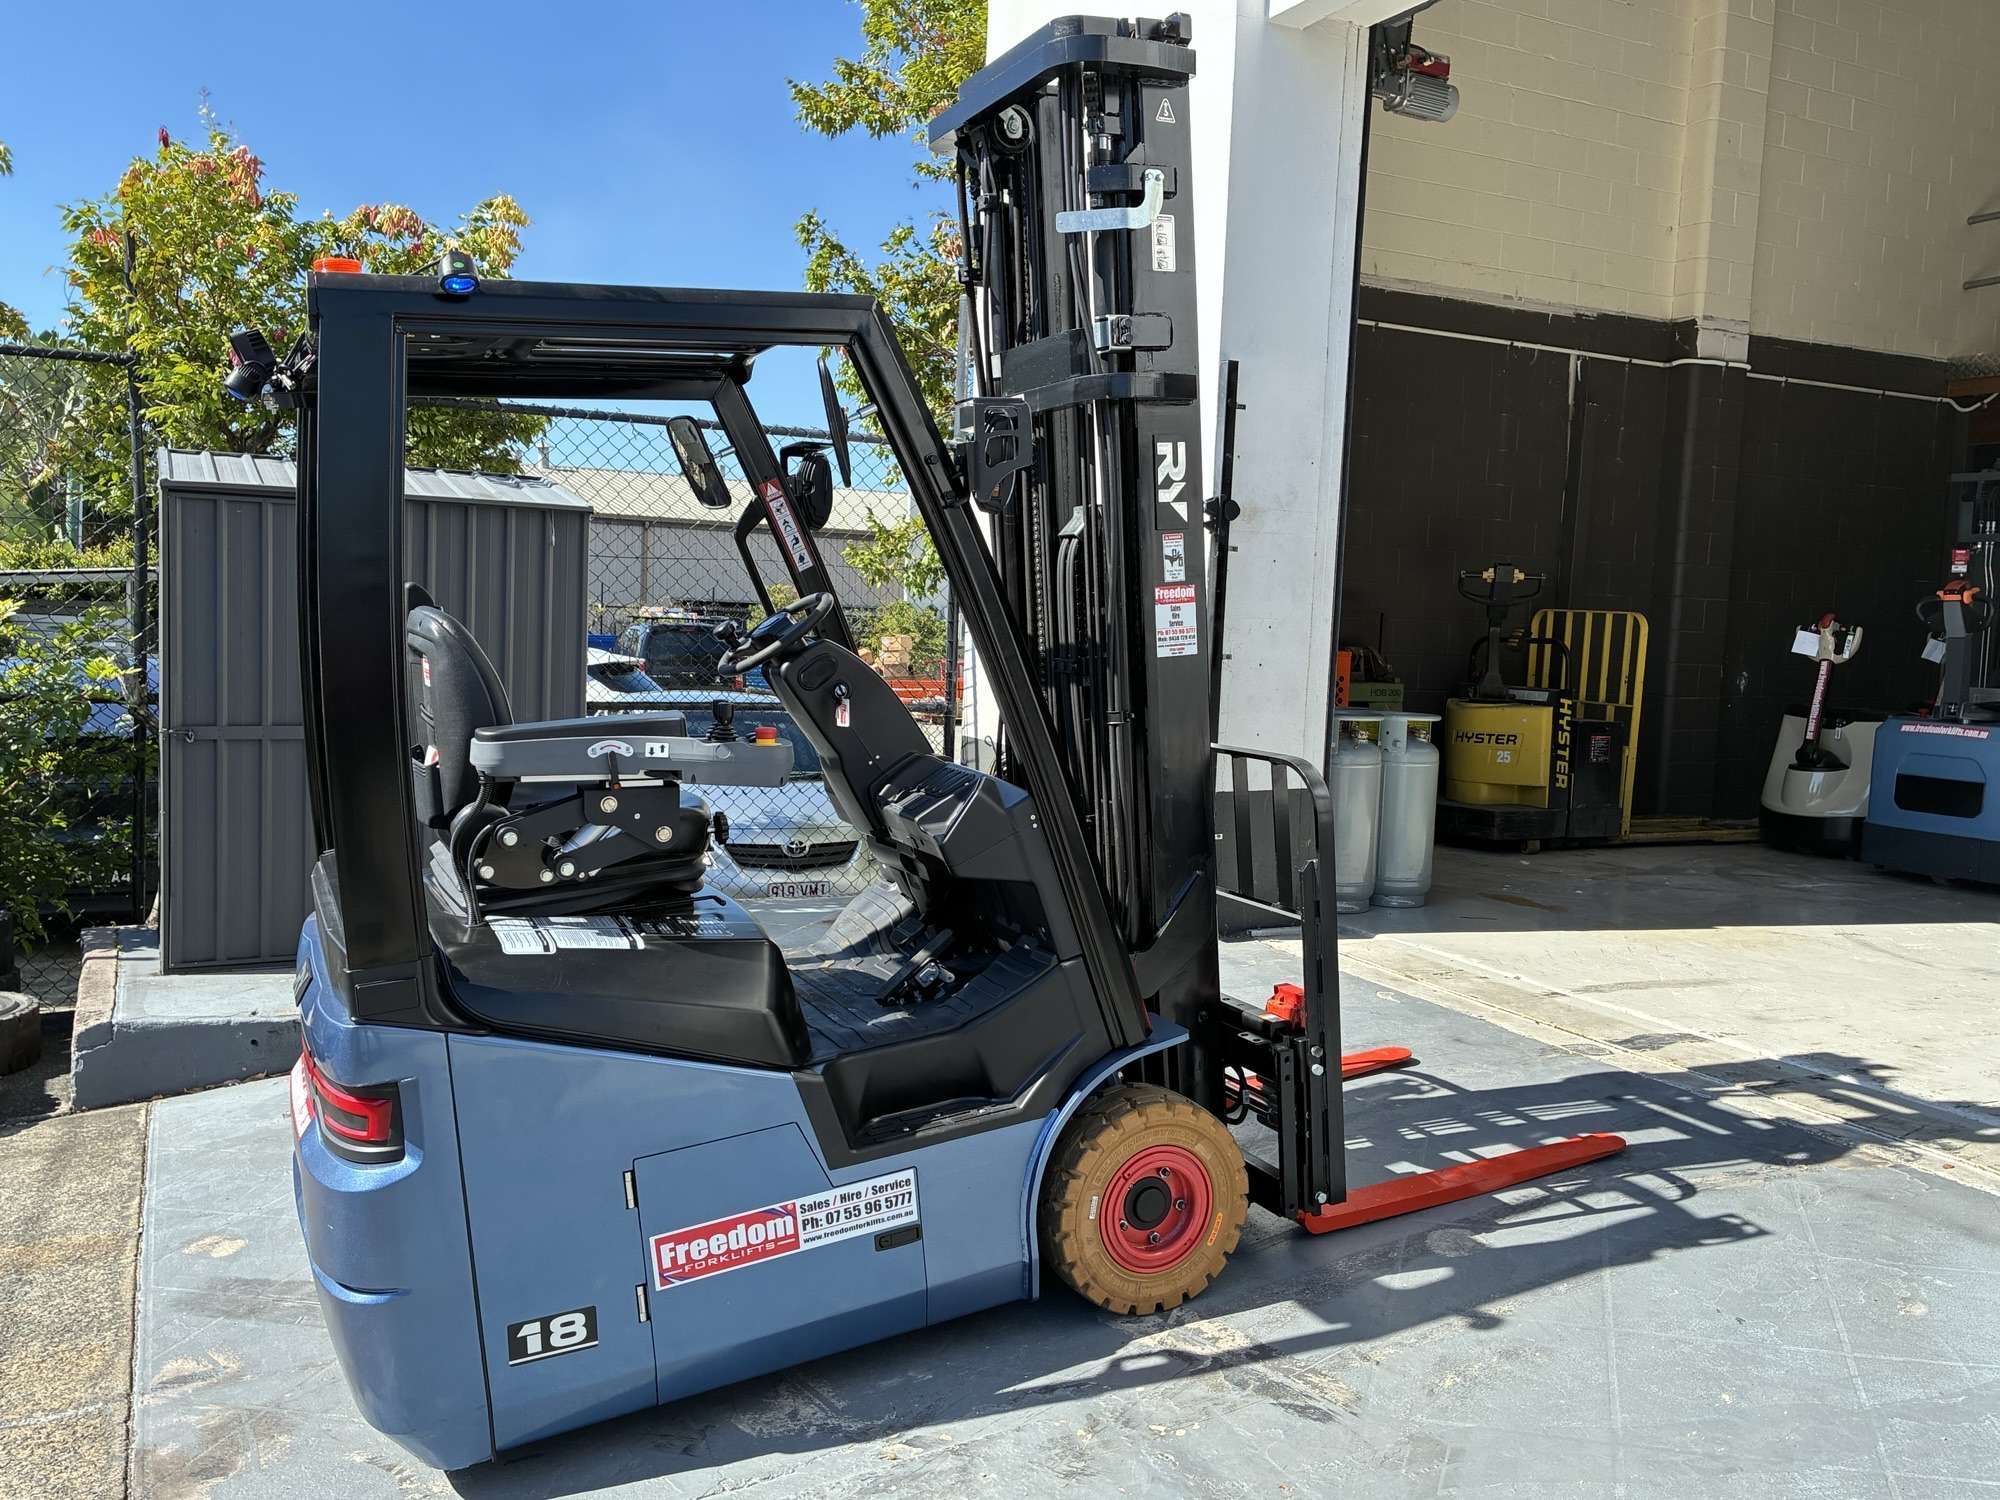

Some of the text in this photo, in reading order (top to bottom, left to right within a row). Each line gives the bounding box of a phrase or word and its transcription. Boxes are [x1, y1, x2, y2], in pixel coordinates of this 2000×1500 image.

[1156, 441, 1188, 522] RY
[1155, 586, 1195, 600] Freedom
[1455, 731, 1518, 745] HYSTER
[1555, 697, 1573, 790] HYSTER
[1496, 750, 1511, 763] 25
[799, 1178, 912, 1214] Sales / Hire / Service
[802, 1191, 913, 1232] Ph: 07 55 96 5777
[660, 1215, 795, 1269] Freedom
[803, 1209, 914, 1244] www.freedomforklifts.com.au
[684, 1241, 776, 1272] FORKLIFTS
[516, 1312, 588, 1355] 18
